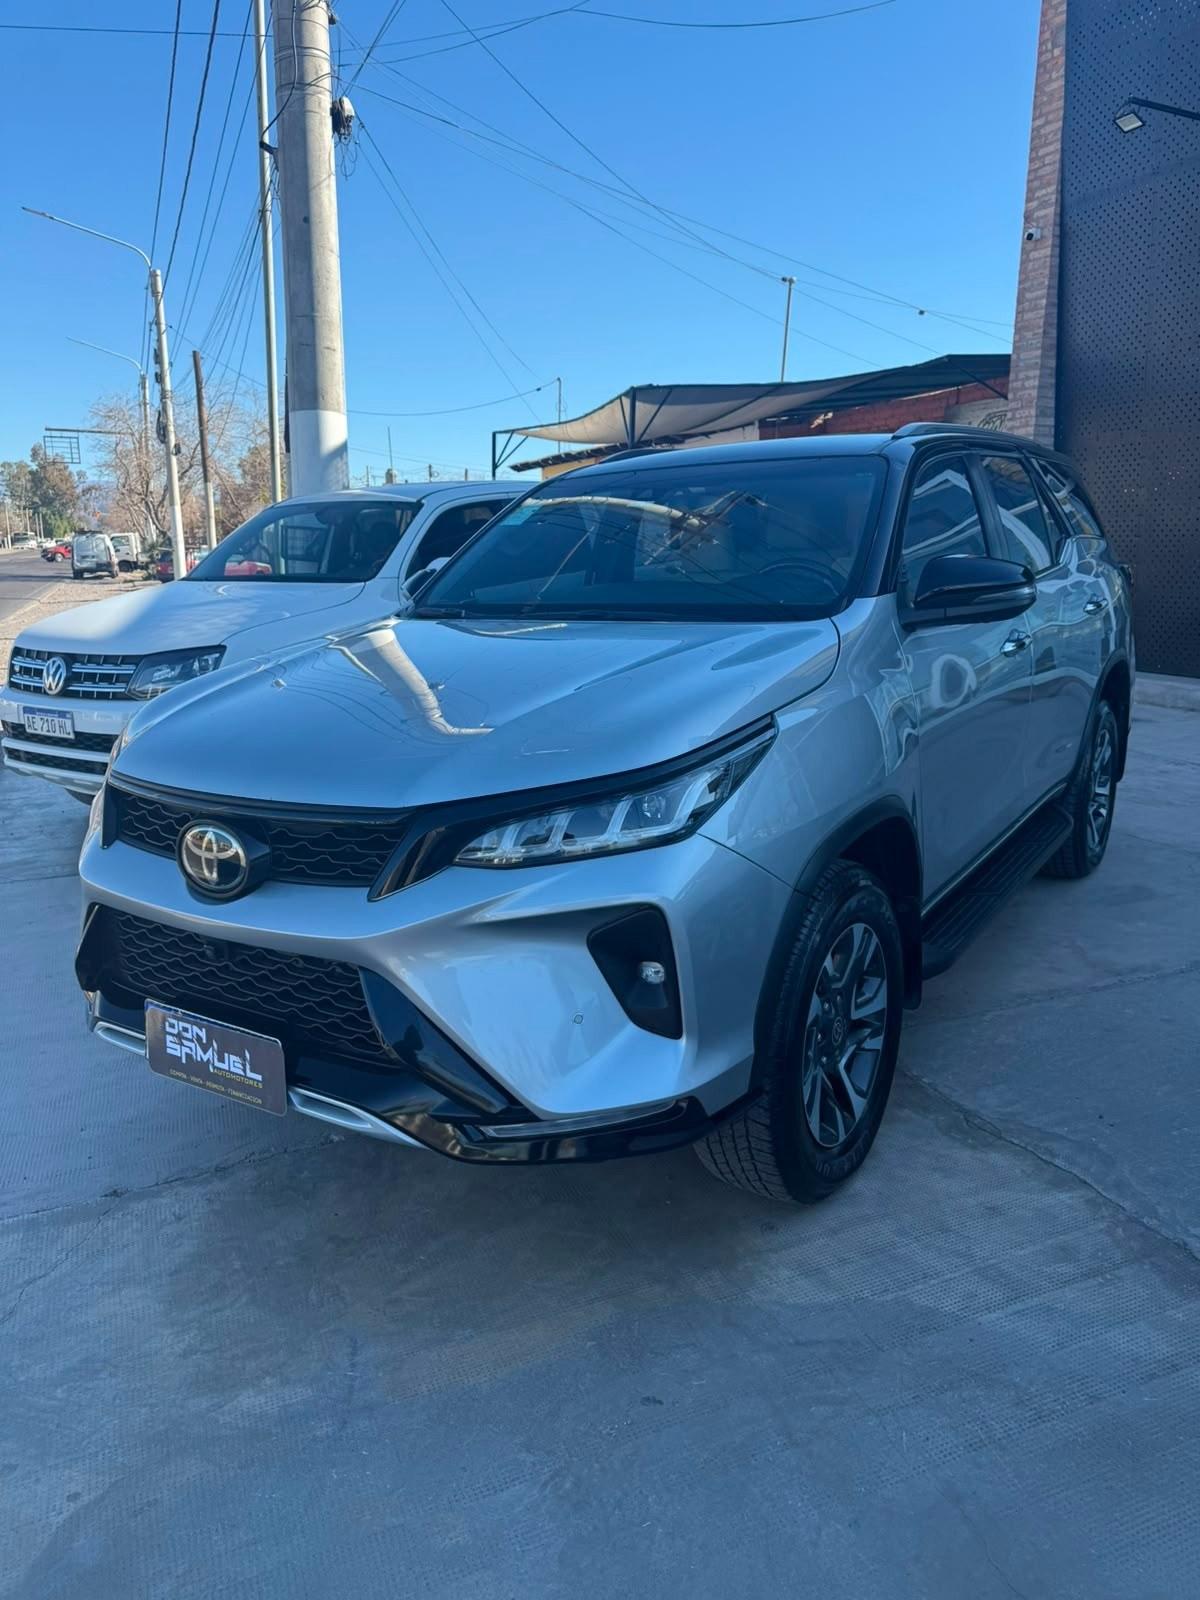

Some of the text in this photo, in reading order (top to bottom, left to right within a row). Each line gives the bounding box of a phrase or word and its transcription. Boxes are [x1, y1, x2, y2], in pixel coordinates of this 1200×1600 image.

[26, 716, 71, 736] AE 710 HL
[165, 1017, 206, 1043] DON
[165, 1035, 262, 1081] SAMUEL
[213, 1068, 263, 1089] AUTOMOTORES
